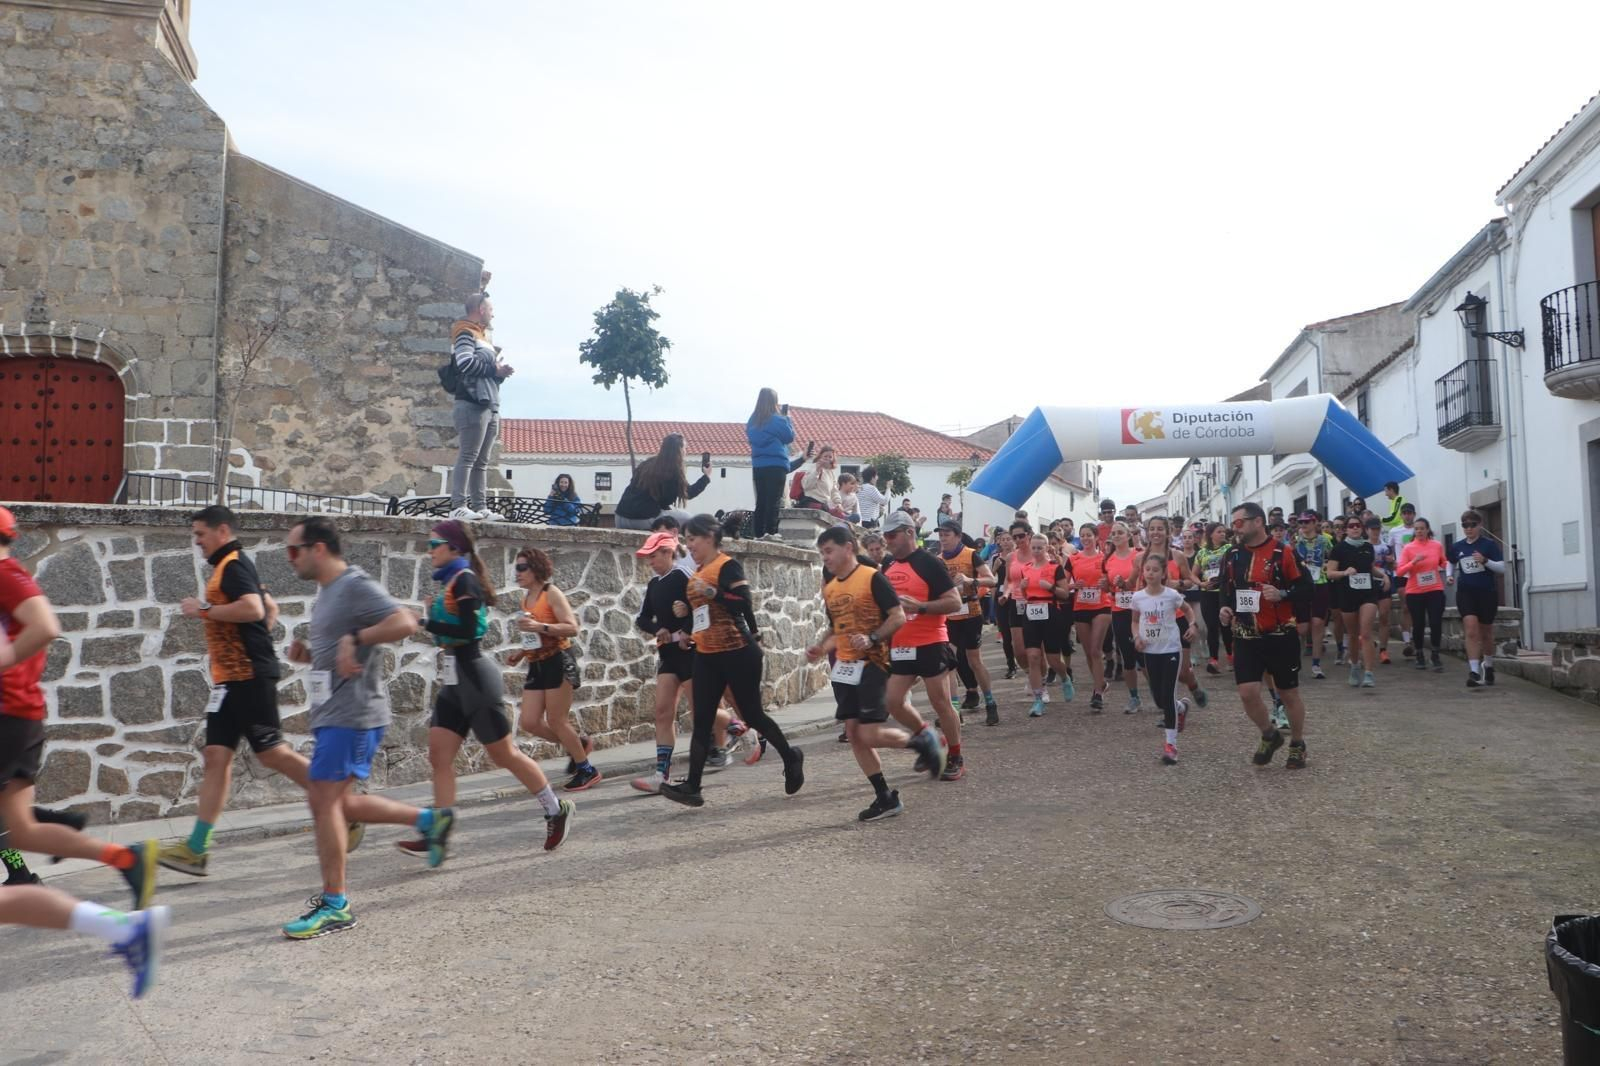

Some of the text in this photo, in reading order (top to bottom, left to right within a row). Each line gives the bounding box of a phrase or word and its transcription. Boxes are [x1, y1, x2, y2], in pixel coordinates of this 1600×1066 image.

[1172, 410, 1254, 426] Diputación
[1172, 425, 1255, 440] de Córdoba
[1240, 596, 1254, 606] 386
[1030, 607, 1043, 615] 354
[1145, 628, 1161, 638] 387
